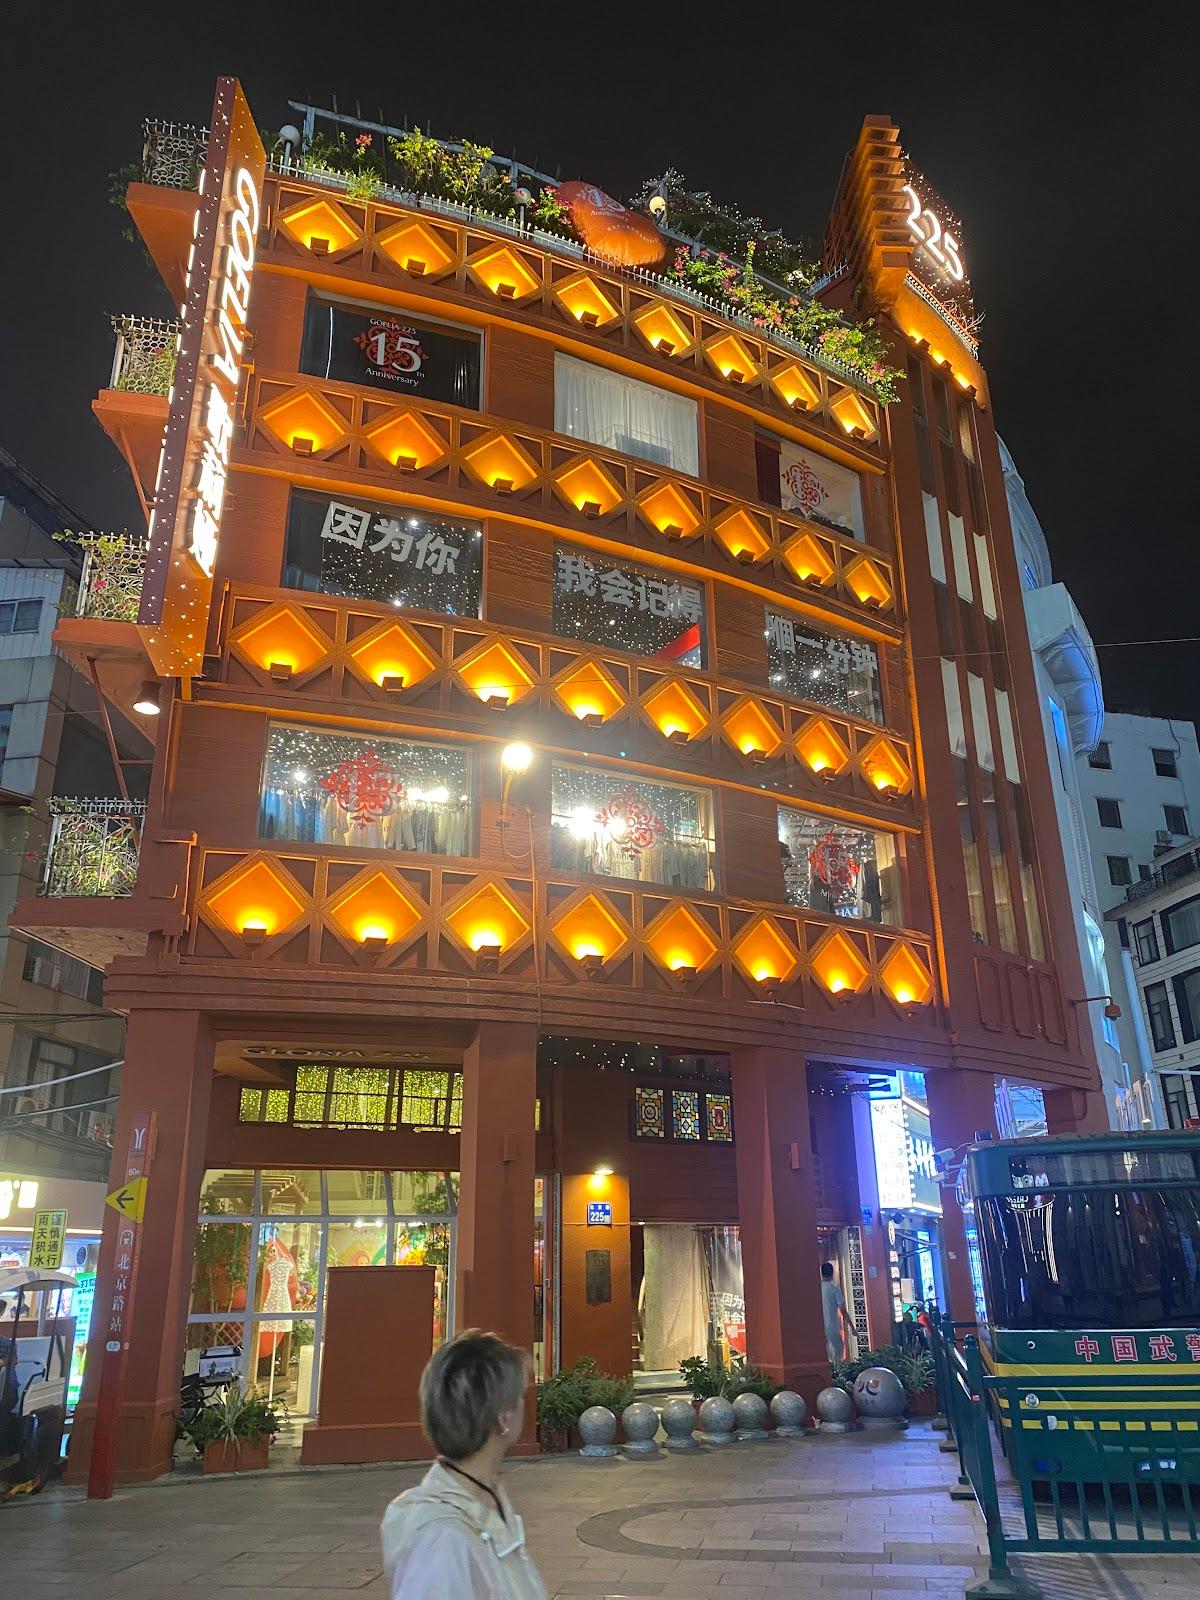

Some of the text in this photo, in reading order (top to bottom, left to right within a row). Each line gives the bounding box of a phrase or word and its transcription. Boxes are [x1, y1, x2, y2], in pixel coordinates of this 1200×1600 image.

[903, 186, 964, 280] 225
[214, 168, 259, 385] GOELIA
[369, 318, 417, 335] GOELIA 225
[370, 333, 422, 373] 15
[365, 367, 420, 387] Anniversary
[320, 501, 460, 575] 因为你
[558, 554, 702, 623] 我会记得
[34, 1214, 49, 1267] 雨天积水
[591, 1211, 605, 1222] 225
[110, 1253, 131, 1332] 北京路站
